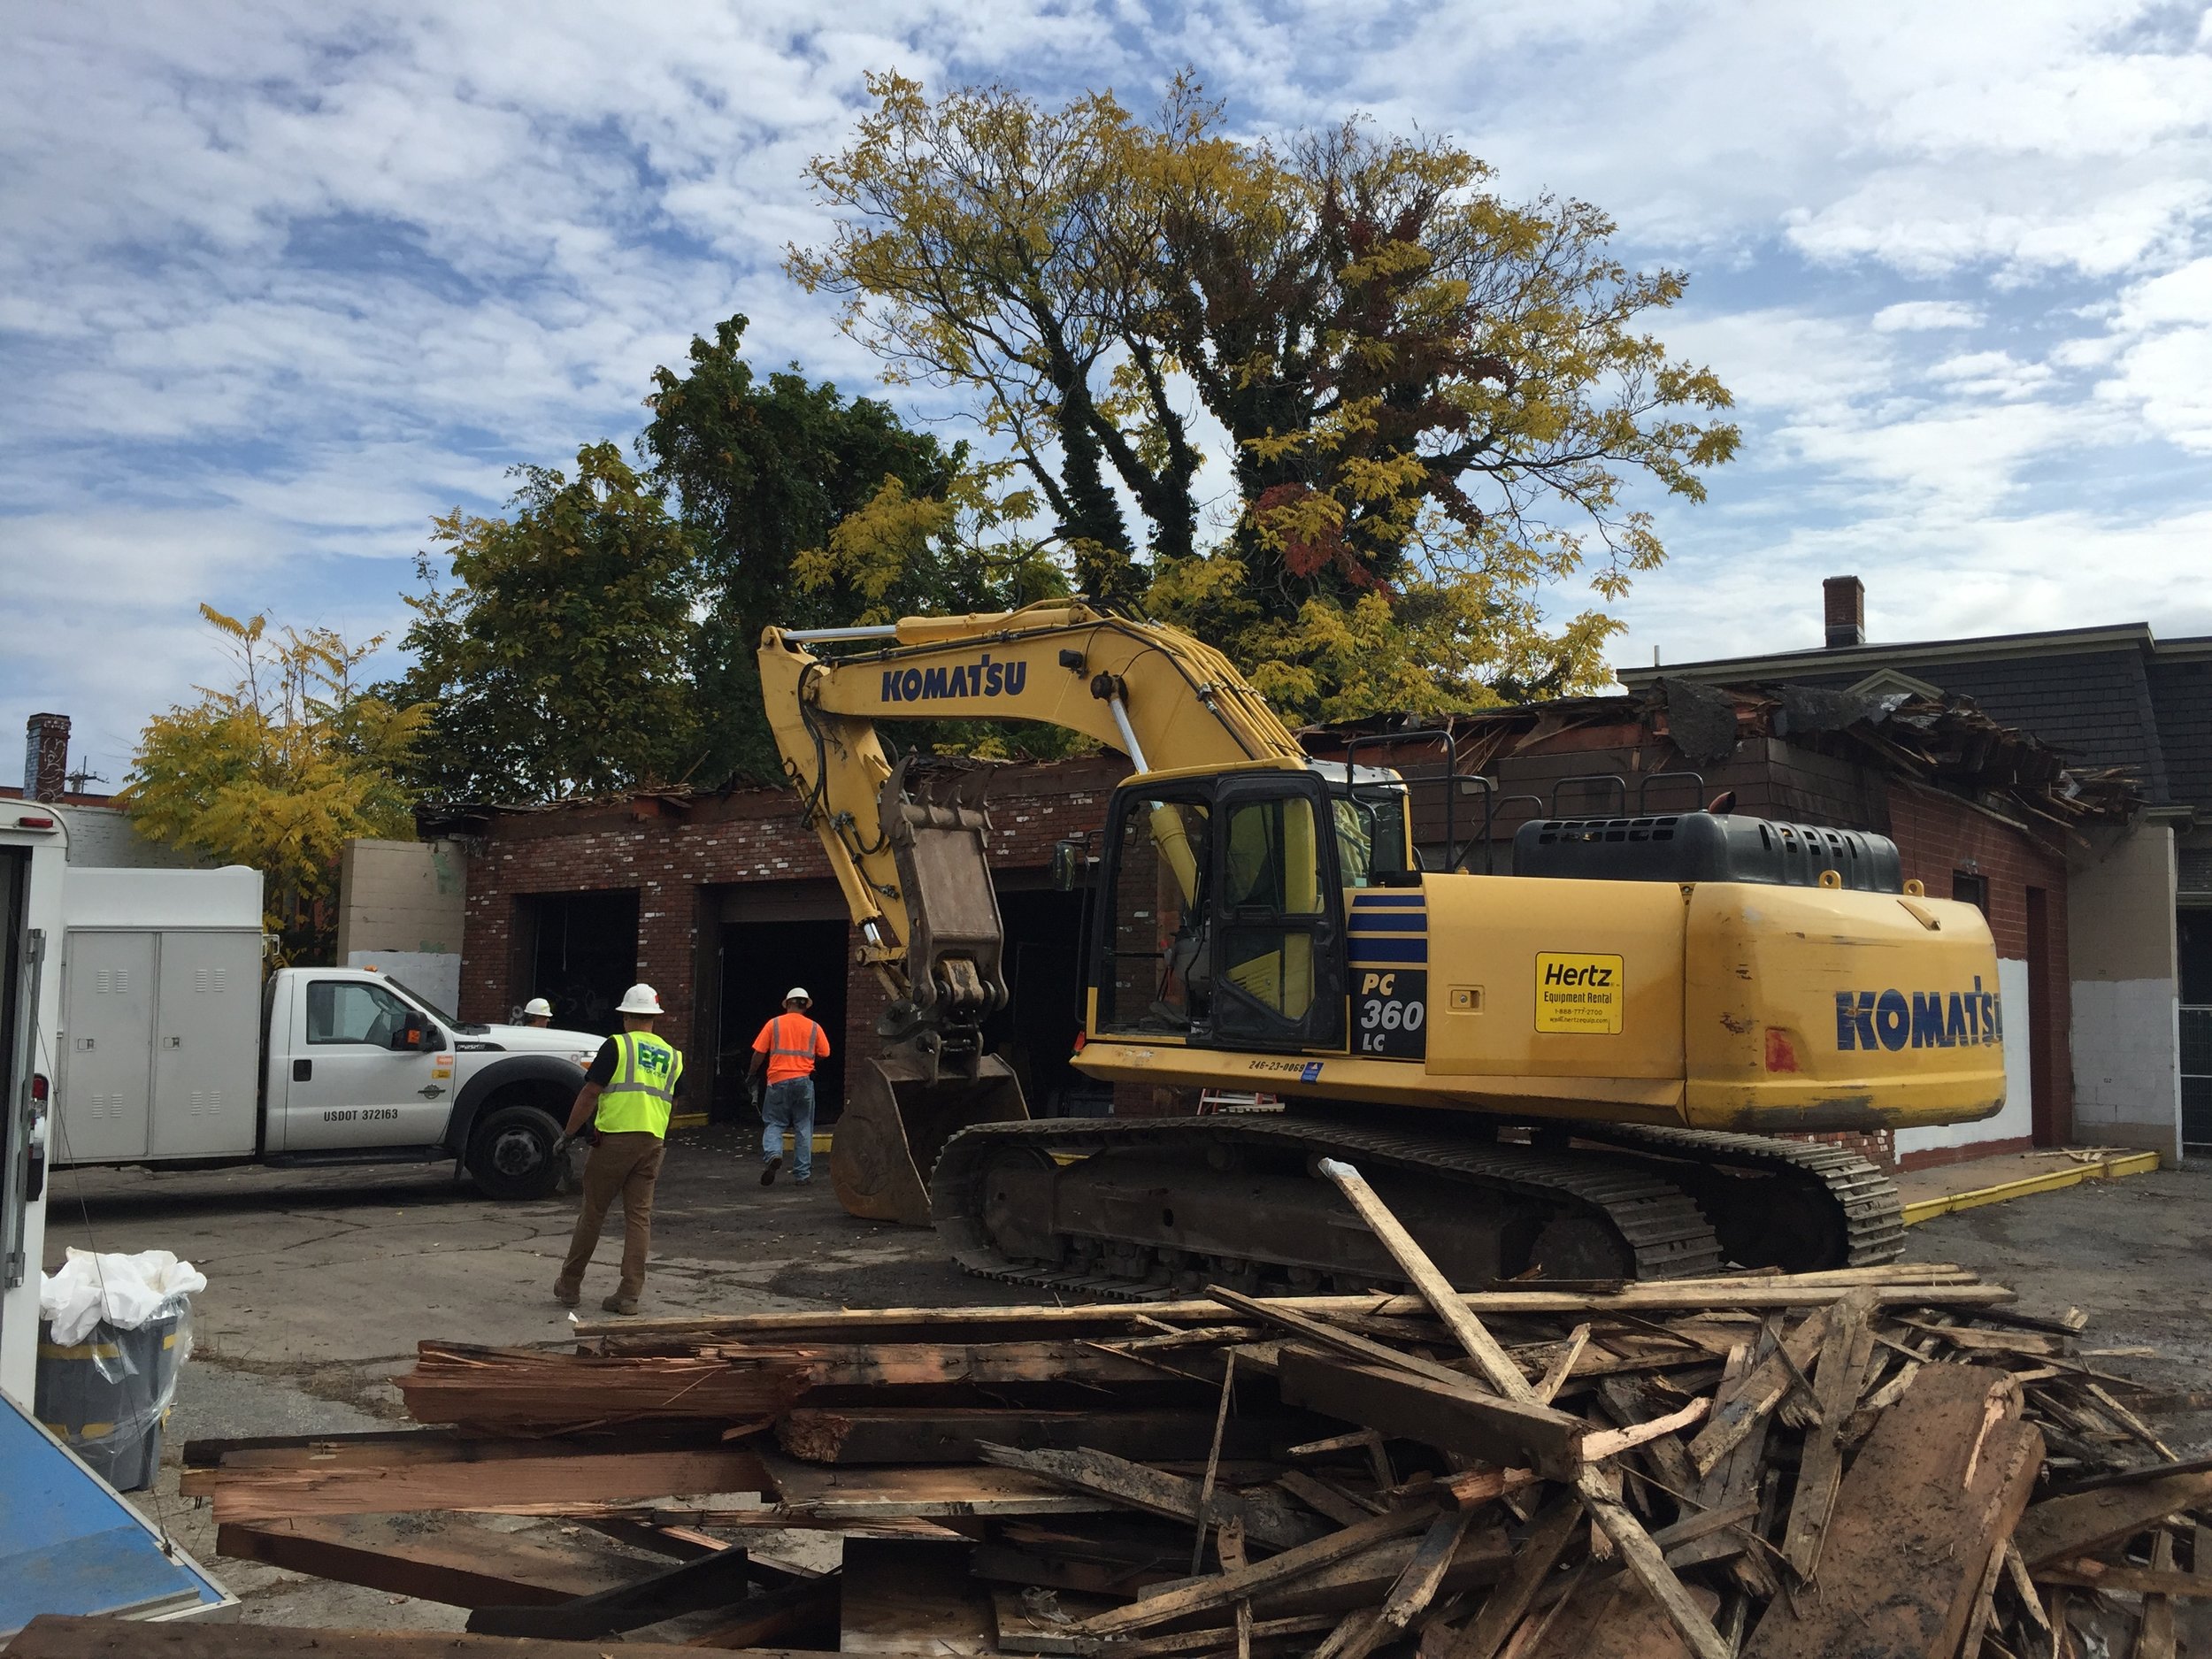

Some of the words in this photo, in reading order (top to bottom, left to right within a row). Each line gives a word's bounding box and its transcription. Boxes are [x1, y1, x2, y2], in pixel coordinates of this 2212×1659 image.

[881, 654, 1027, 703] KOMATSU
[1361, 973, 1395, 996] PC
[1544, 964, 1613, 987] Hertz
[1544, 991, 1586, 1003] Equipment
[1587, 992, 1612, 1004] Rental
[1360, 999, 1425, 1031] 360
[1362, 1033, 1386, 1052] LC
[1248, 1061, 1305, 1072] 246-23-0069
[324, 1110, 358, 1122] USDOT
[362, 1108, 398, 1120] 372163
